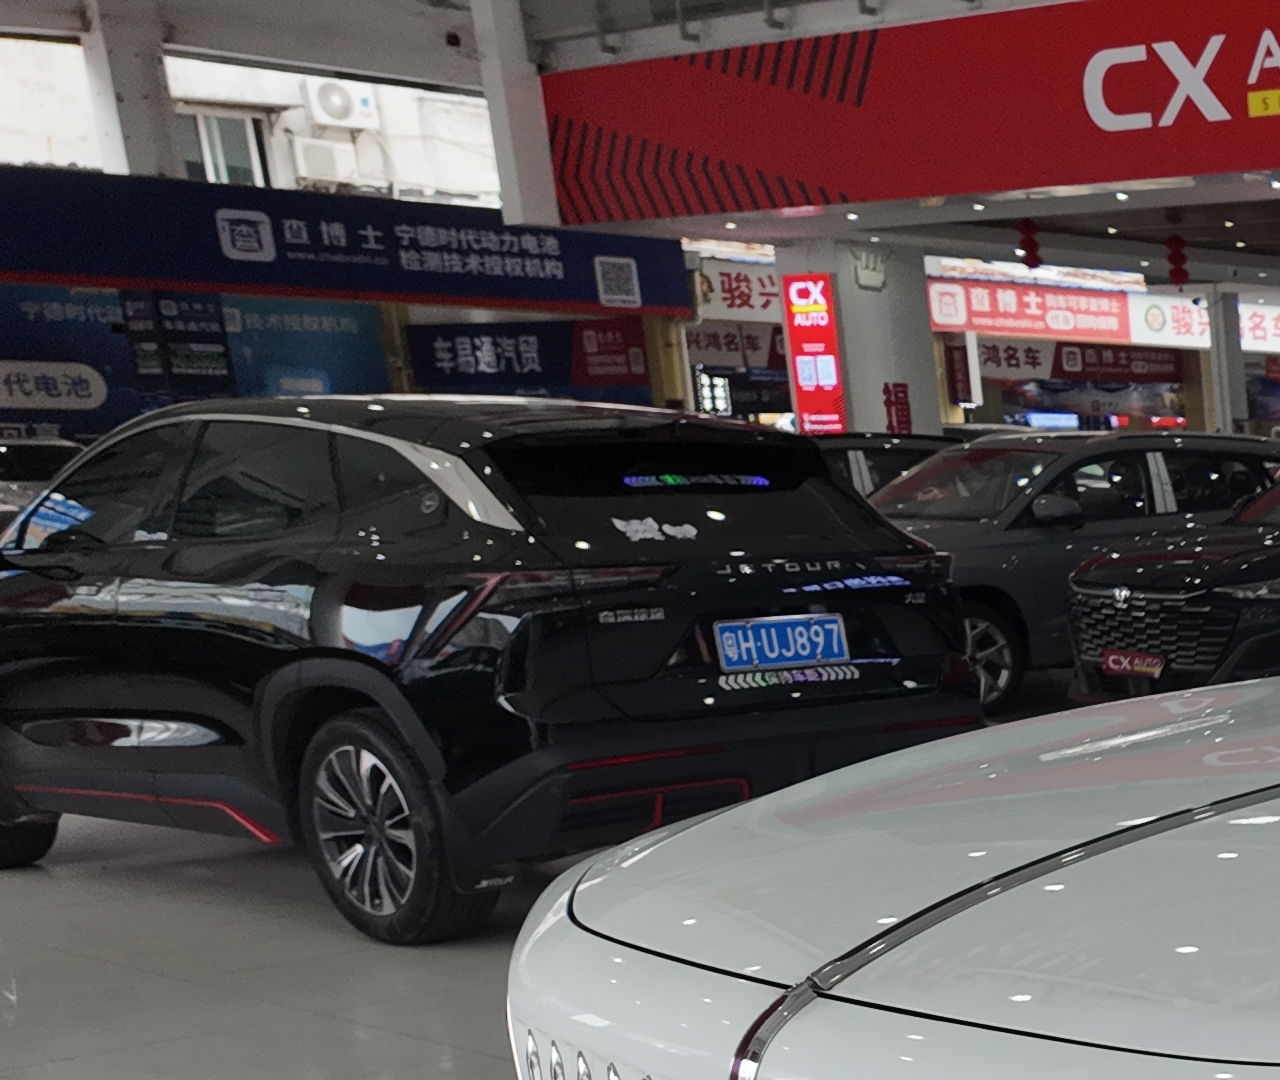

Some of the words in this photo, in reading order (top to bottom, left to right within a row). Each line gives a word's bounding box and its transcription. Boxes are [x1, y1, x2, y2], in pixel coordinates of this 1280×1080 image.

[1083, 34, 1232, 132] CX
[789, 281, 827, 305] CX
[794, 312, 829, 327] AUTO
[1108, 655, 1131, 671] CX
